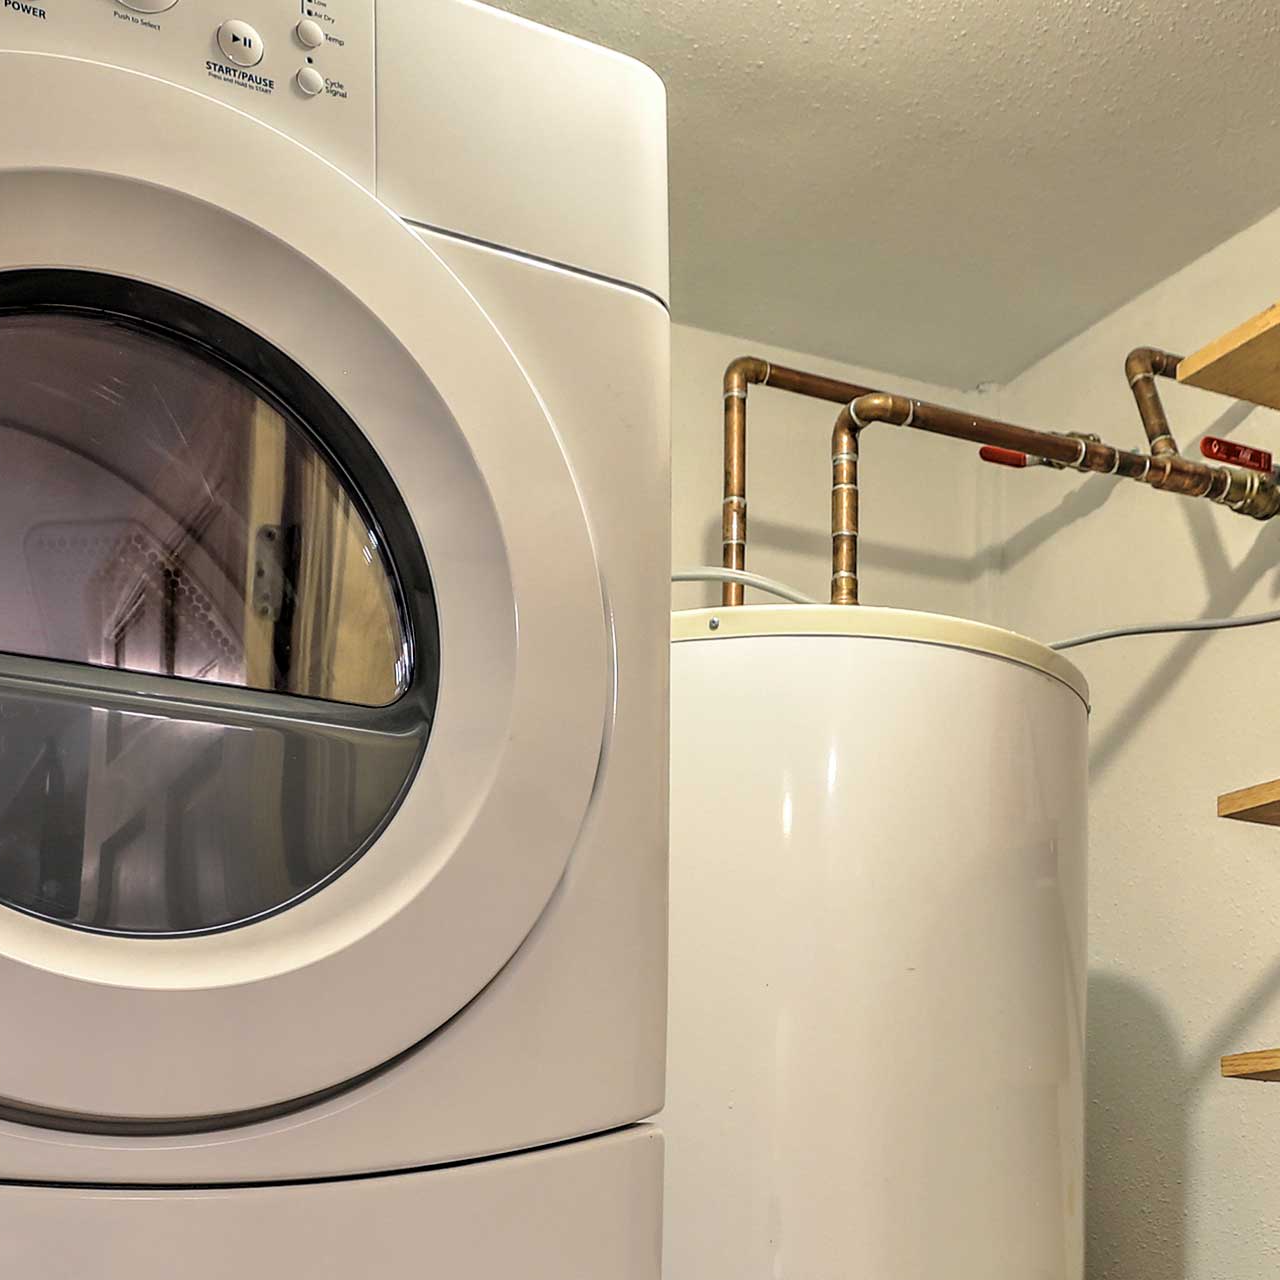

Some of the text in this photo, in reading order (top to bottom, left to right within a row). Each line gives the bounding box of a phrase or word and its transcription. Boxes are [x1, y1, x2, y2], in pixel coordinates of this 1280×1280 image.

[5, 0, 46, 19] POWER
[113, 10, 161, 31] Push to Select
[324, 33, 345, 47] Temp
[206, 60, 275, 90] START/PAUSE
[325, 78, 345, 91] Cycle
[325, 86, 347, 99] Signal
